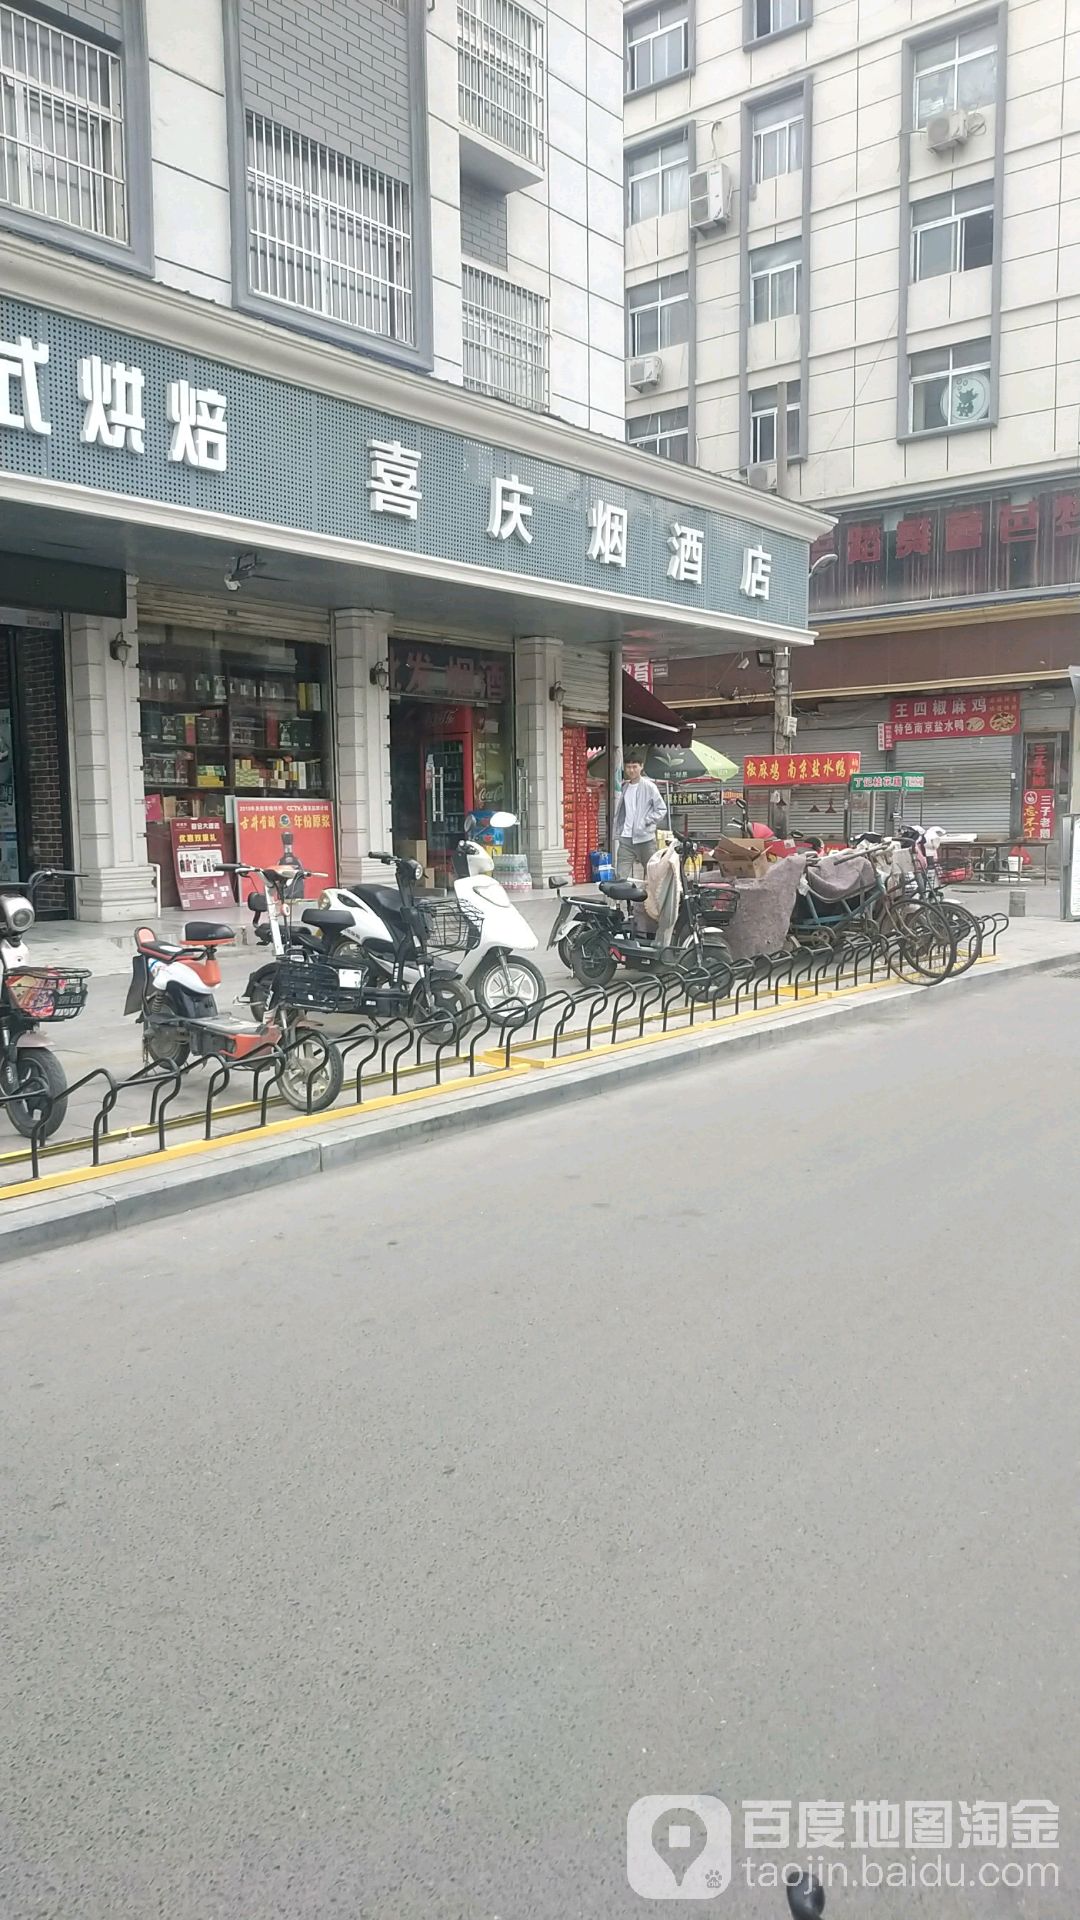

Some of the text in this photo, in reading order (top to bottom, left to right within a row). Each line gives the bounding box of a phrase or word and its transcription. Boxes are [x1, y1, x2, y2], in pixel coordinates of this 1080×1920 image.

[0, 336, 228, 472] 式烘焙
[366, 438, 773, 601] 喜庆烟酒店
[895, 696, 987, 718] 王四椒麻鸡
[894, 719, 965, 735] 特色南京盐水鸭
[746, 760, 780, 781] 椒麻鸡
[787, 757, 846, 779] 南京盐水鸭
[294, 814, 331, 829] 年份原浆
